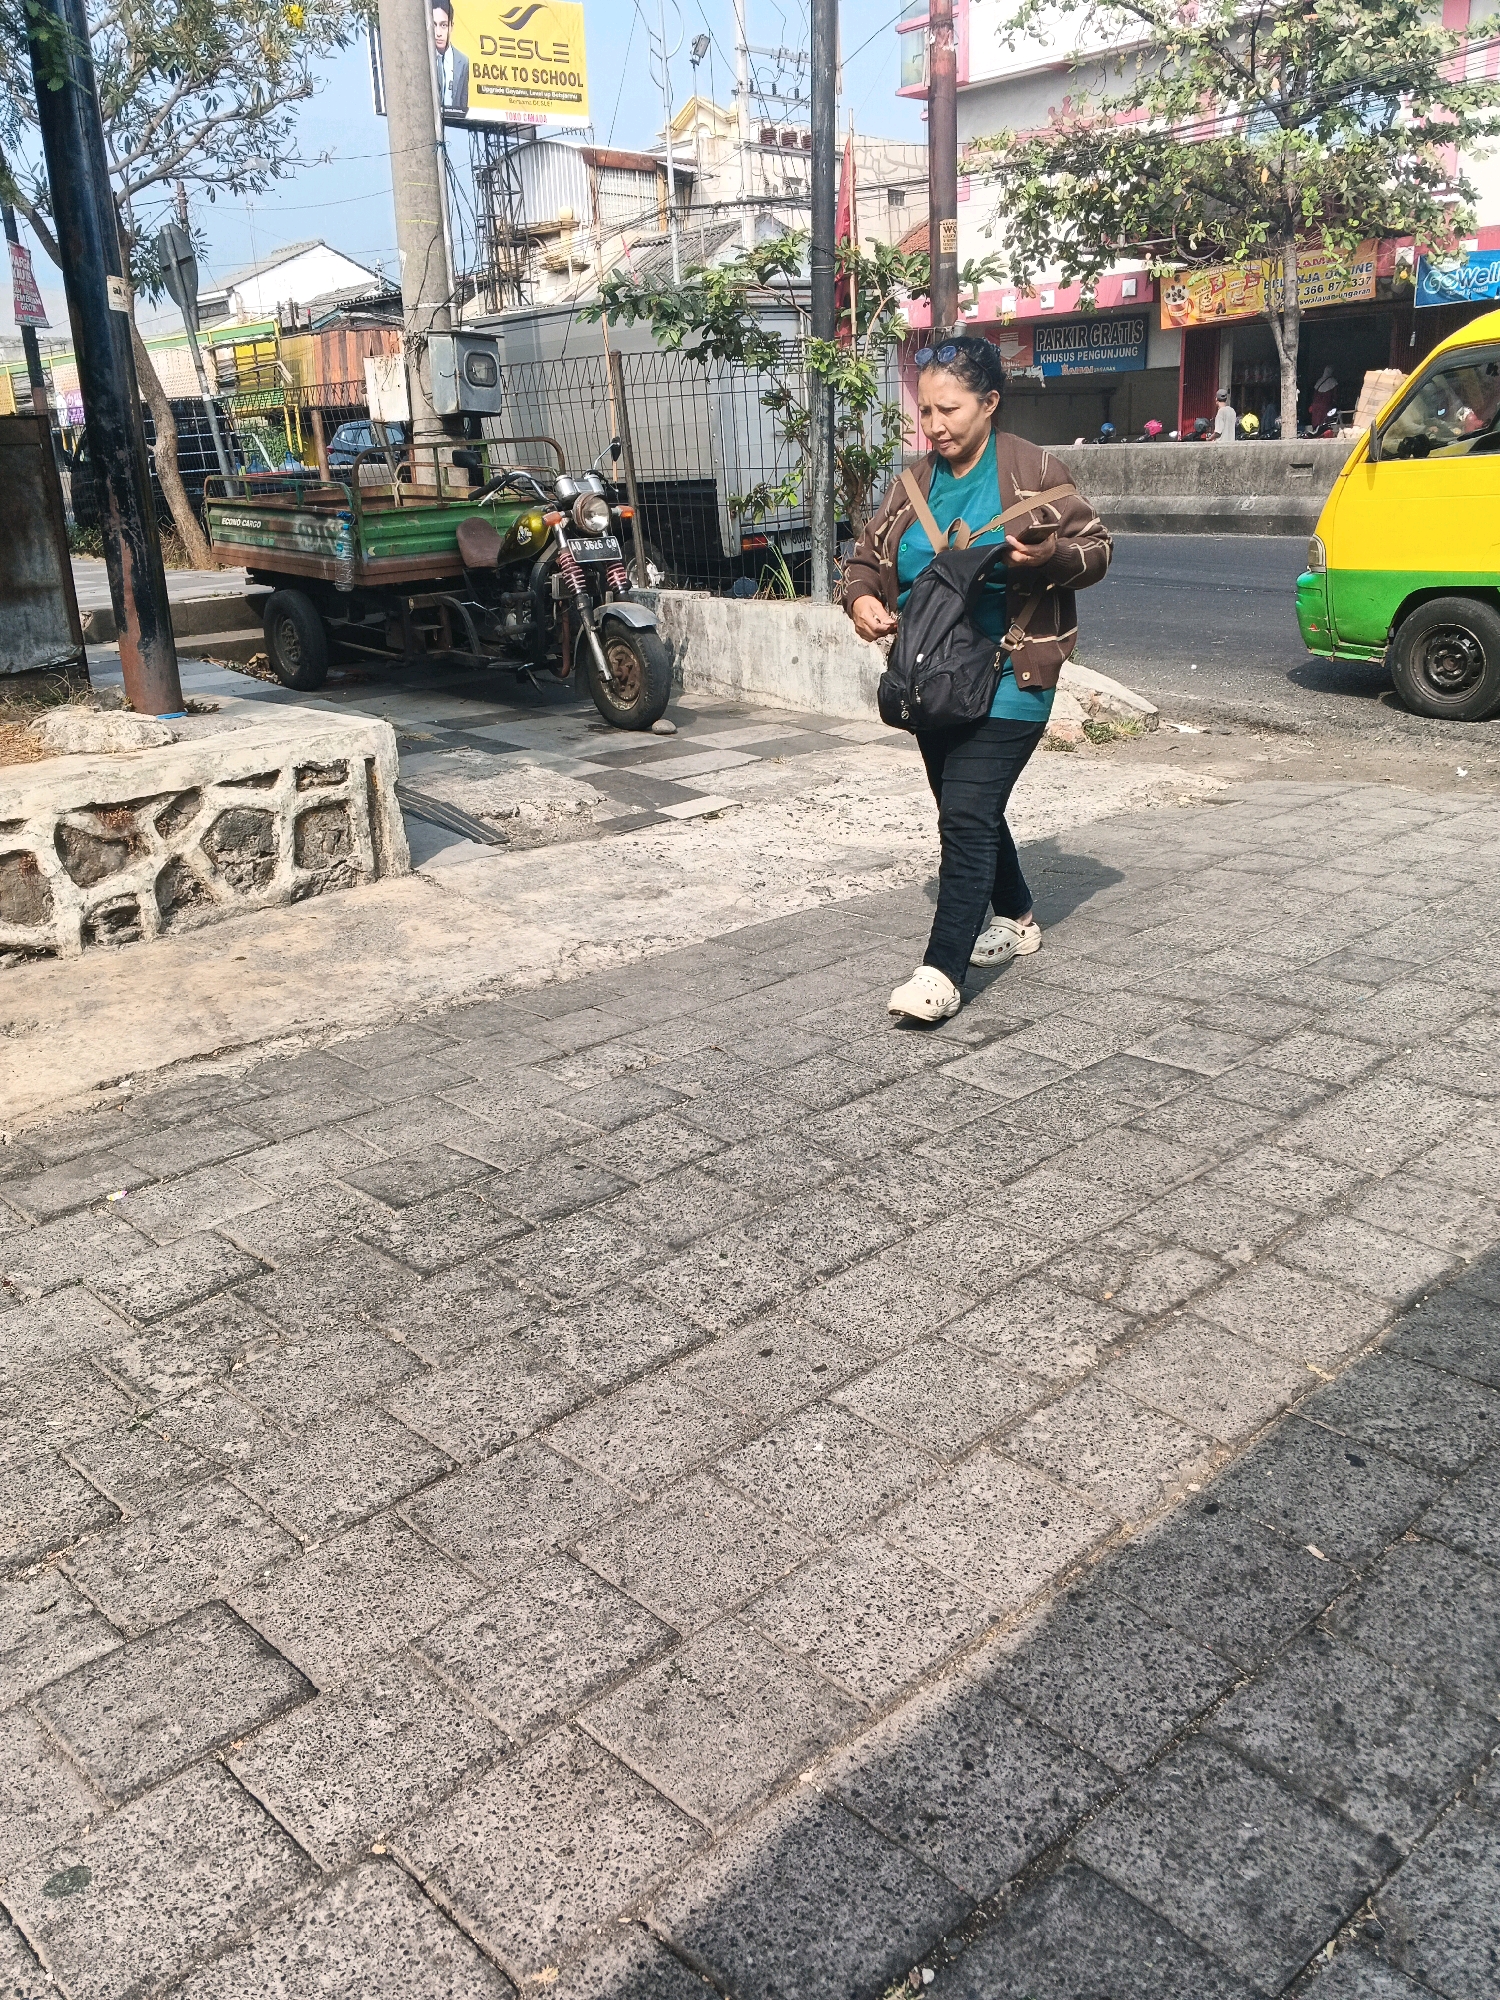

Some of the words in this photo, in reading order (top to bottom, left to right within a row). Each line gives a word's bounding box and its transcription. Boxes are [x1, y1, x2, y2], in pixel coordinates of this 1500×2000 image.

[480, 35, 569, 63] DESLE
[473, 63, 508, 81] BACK
[511, 66, 528, 83] TO
[532, 68, 584, 88] SCHOOL
[505, 111, 522, 122] TOKO
[1263, 273, 1320, 290] BELNJA
[1325, 262, 1373, 280] ONINE
[1303, 283, 1325, 297] 366
[1351, 276, 1372, 288] 337
[1036, 325, 1088, 352] PARKIR
[1090, 319, 1144, 347] GRATIS
[1040, 351, 1075, 364] KHUSUS
[1077, 346, 1139, 361] PENGUNJUNG
[221, 517, 241, 527] ECONO
[241, 519, 262, 529] CARGO
